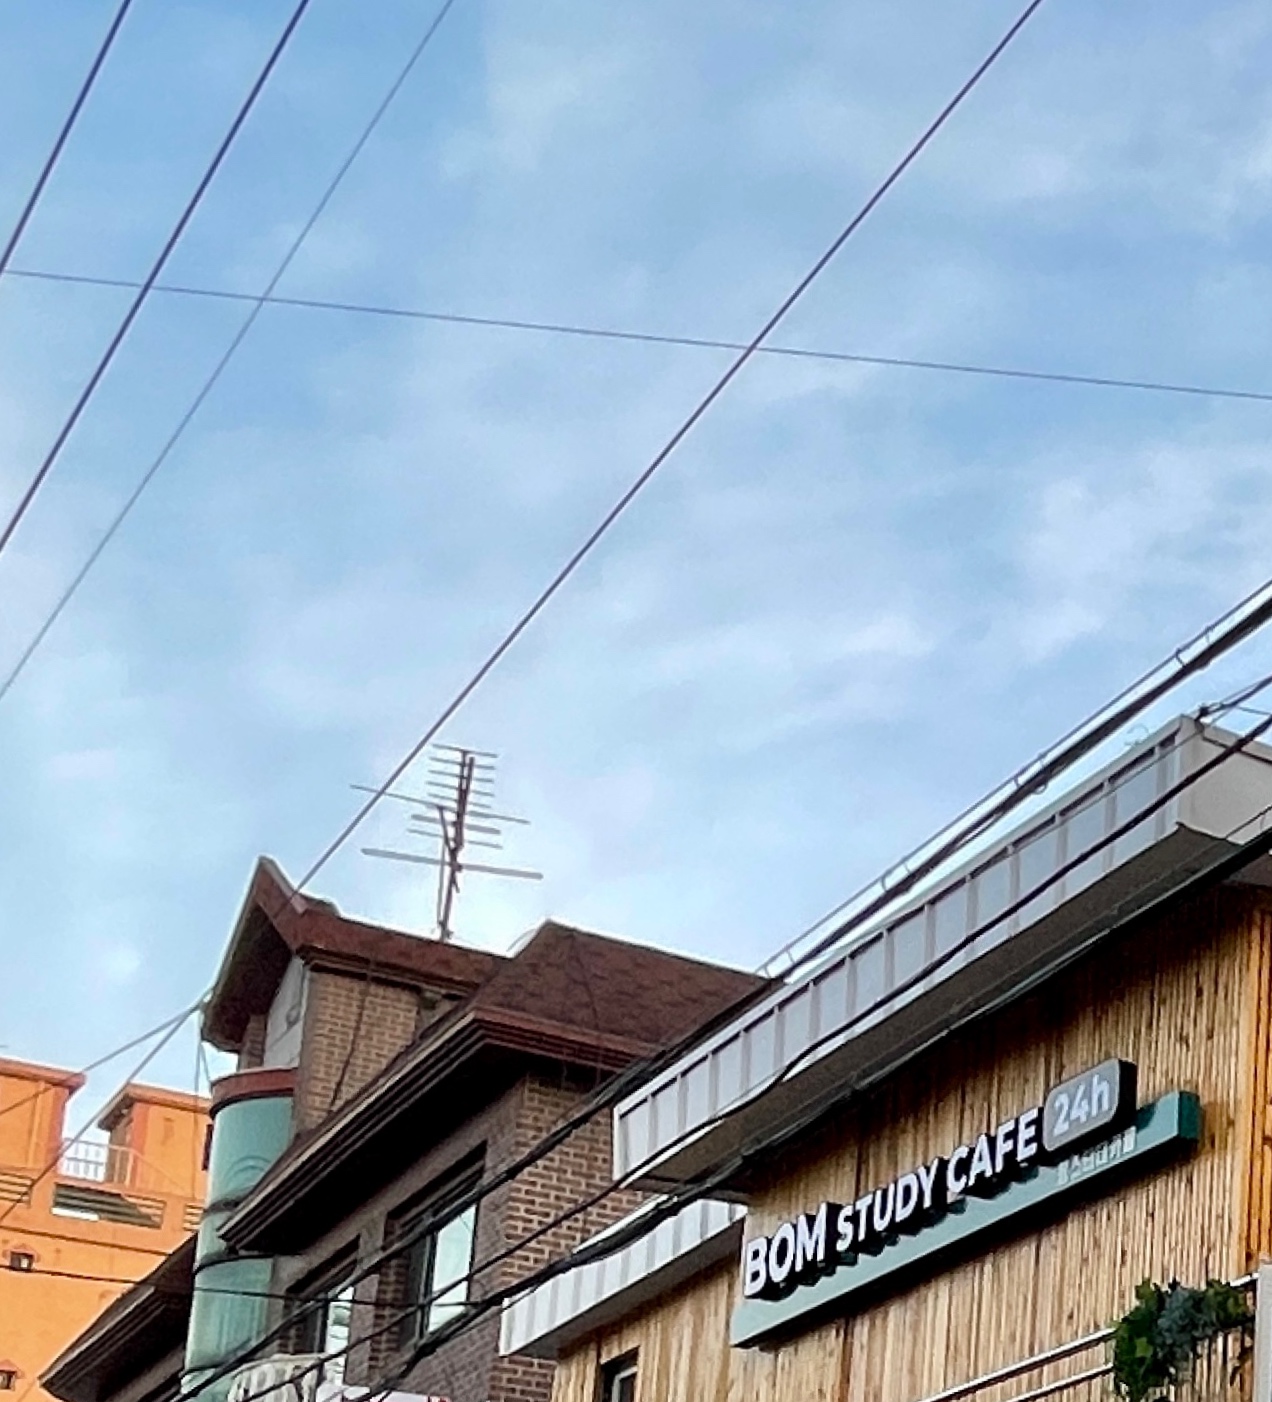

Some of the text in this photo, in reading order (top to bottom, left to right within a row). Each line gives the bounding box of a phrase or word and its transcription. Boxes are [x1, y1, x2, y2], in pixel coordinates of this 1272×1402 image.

[744, 1073, 1113, 1296] BOM STUDY CAFE 24h
